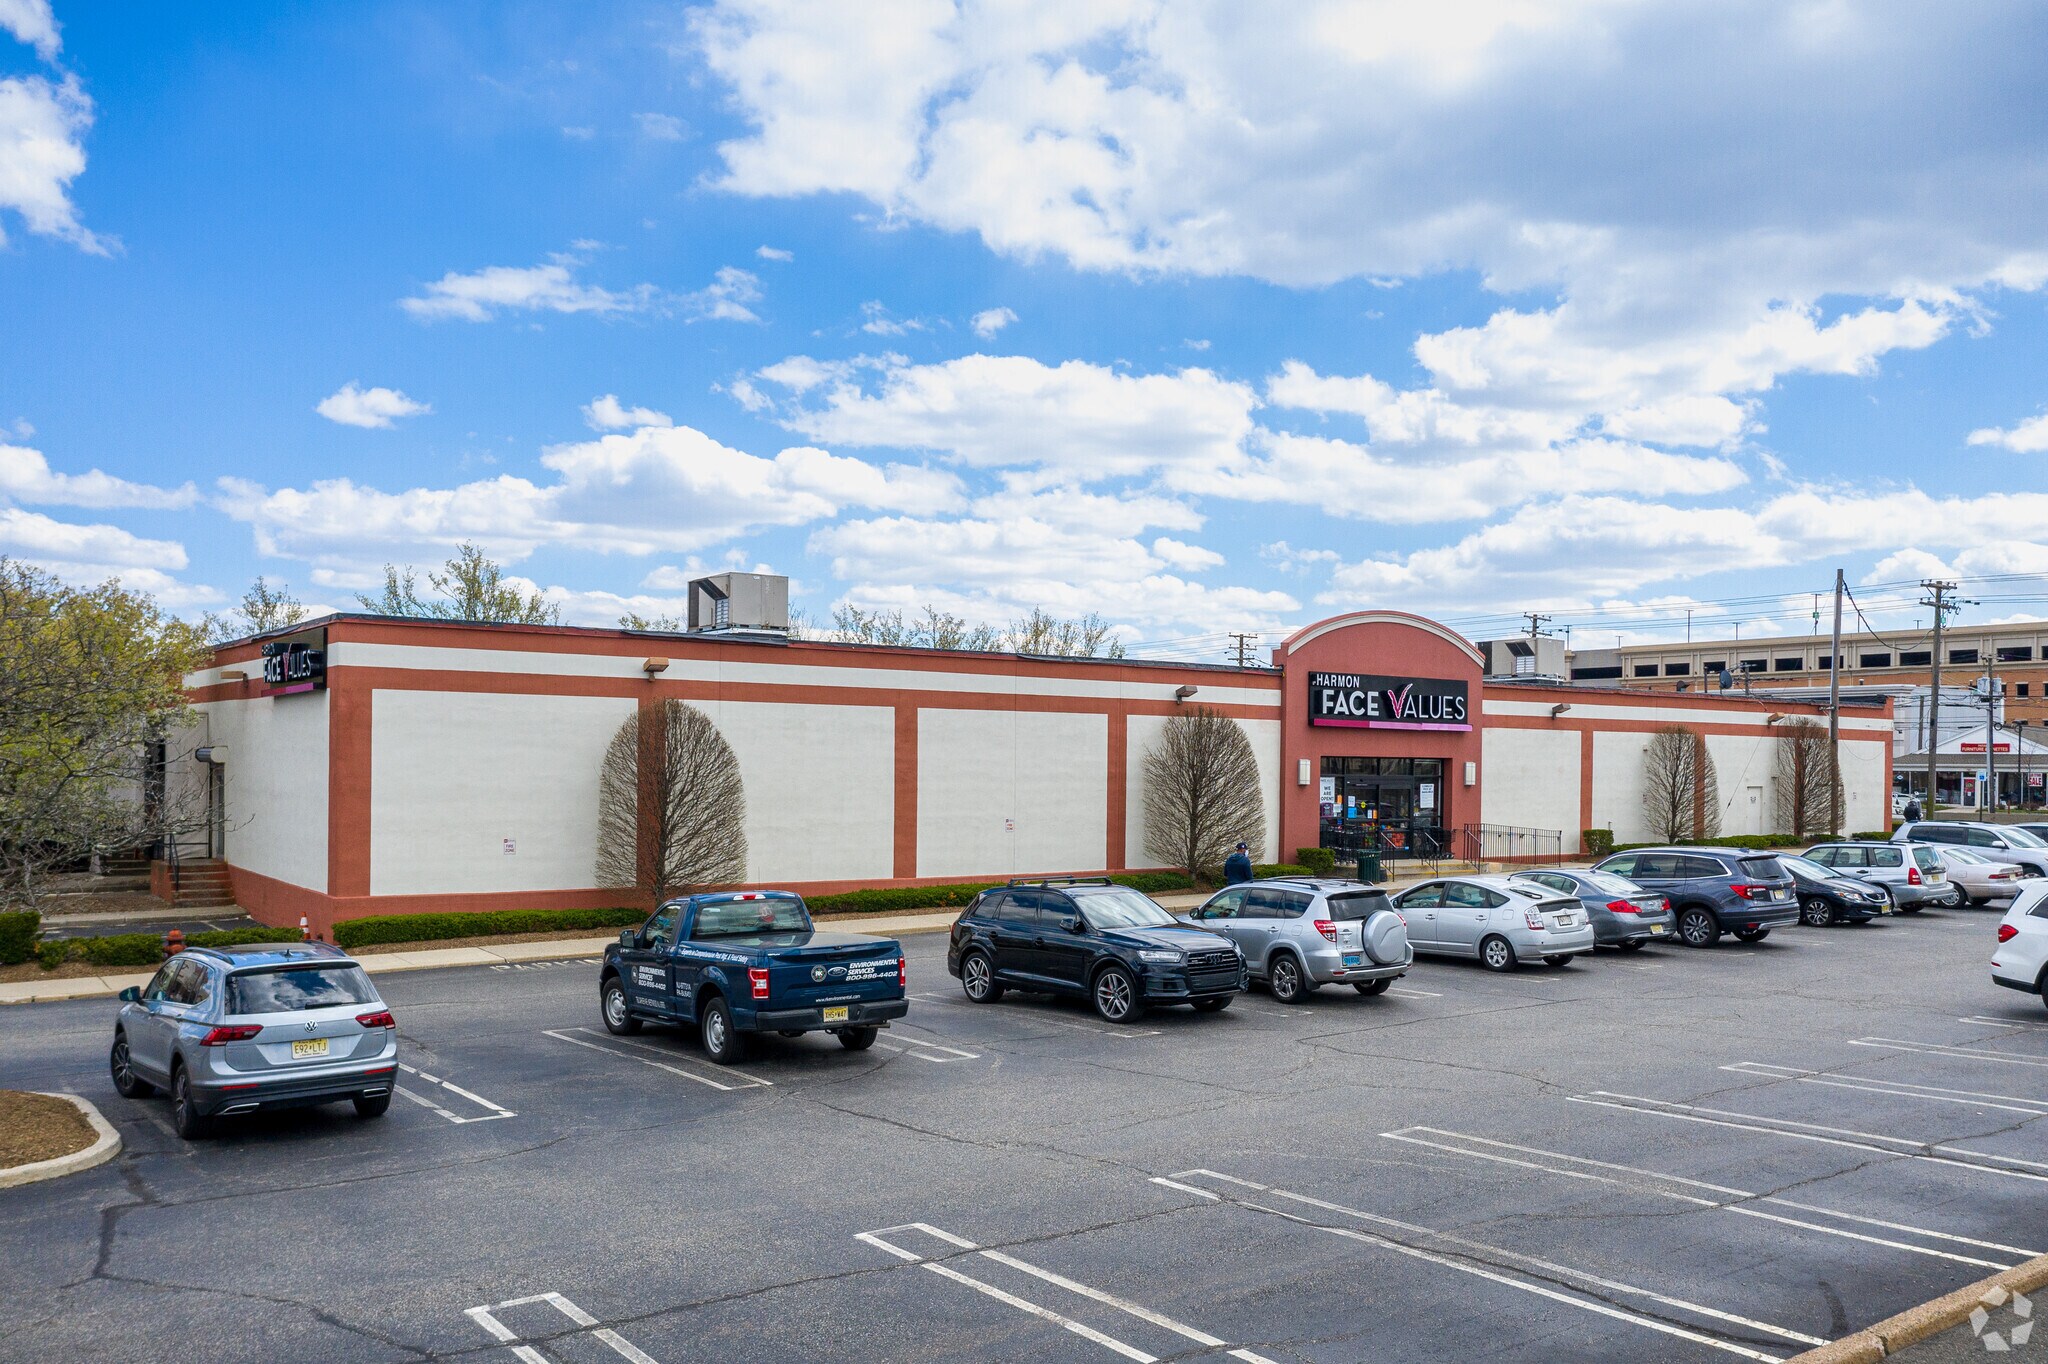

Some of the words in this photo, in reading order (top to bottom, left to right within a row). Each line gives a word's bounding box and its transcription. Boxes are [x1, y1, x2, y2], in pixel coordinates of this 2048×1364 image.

[264, 655, 281, 683] FACE
[283, 642, 311, 682] VALUES
[1316, 673, 1360, 688] HARMON
[1322, 689, 1379, 716] FACE
[1388, 683, 1465, 720] VALUES
[2029, 777, 2041, 786] SALE
[849, 959, 898, 968] ENVIRONMENTAL
[846, 971, 898, 981] 800-996-4402
[848, 967, 875, 975] SERVICES
